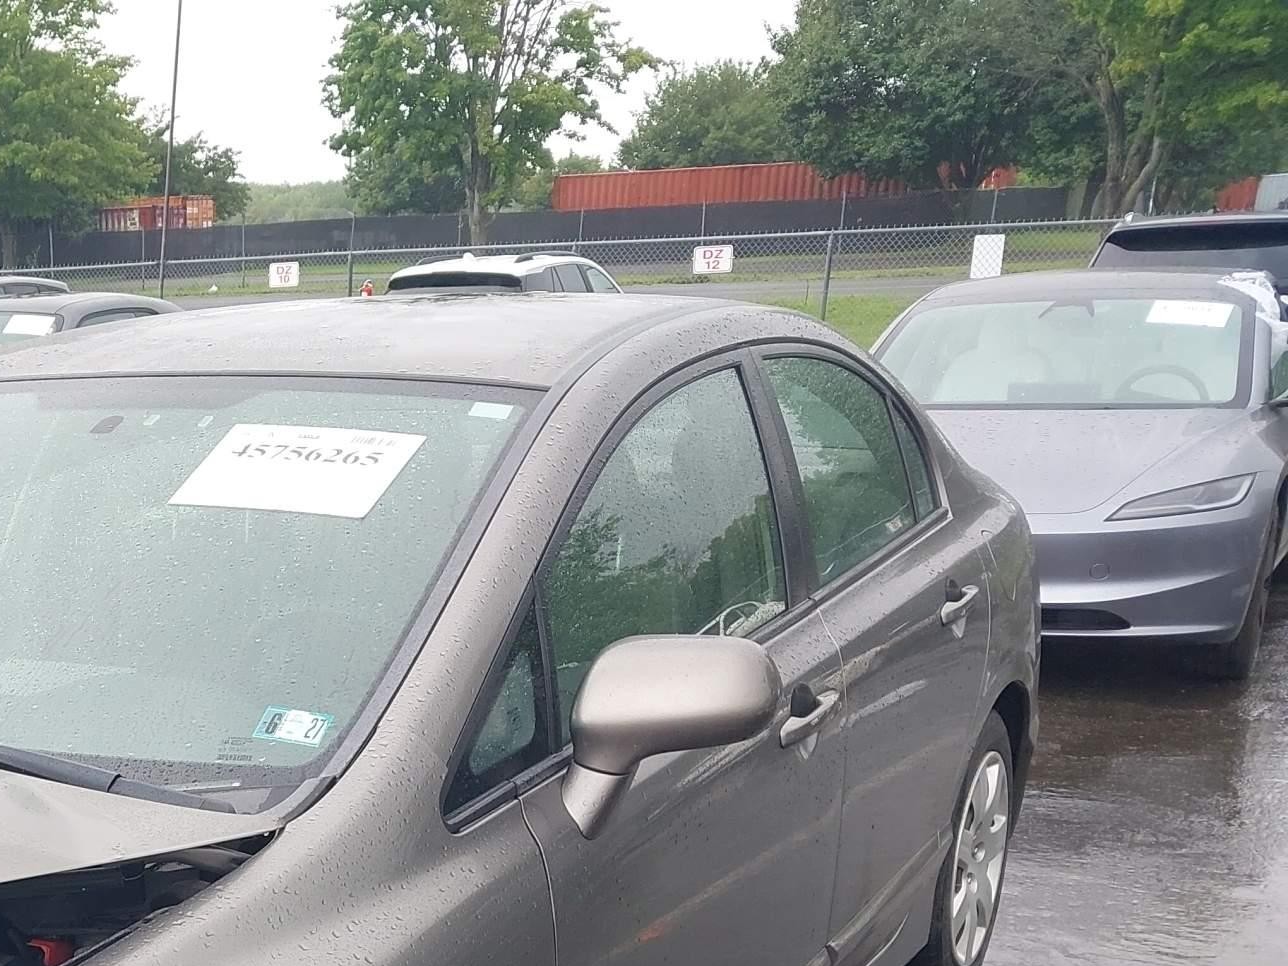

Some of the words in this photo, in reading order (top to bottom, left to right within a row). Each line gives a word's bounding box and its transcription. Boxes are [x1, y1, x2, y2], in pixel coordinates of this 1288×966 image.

[703, 249, 724, 259] DZ
[276, 265, 292, 275] DZ
[704, 260, 720, 270] 12
[278, 275, 290, 284] 10
[232, 443, 384, 466] 45756265
